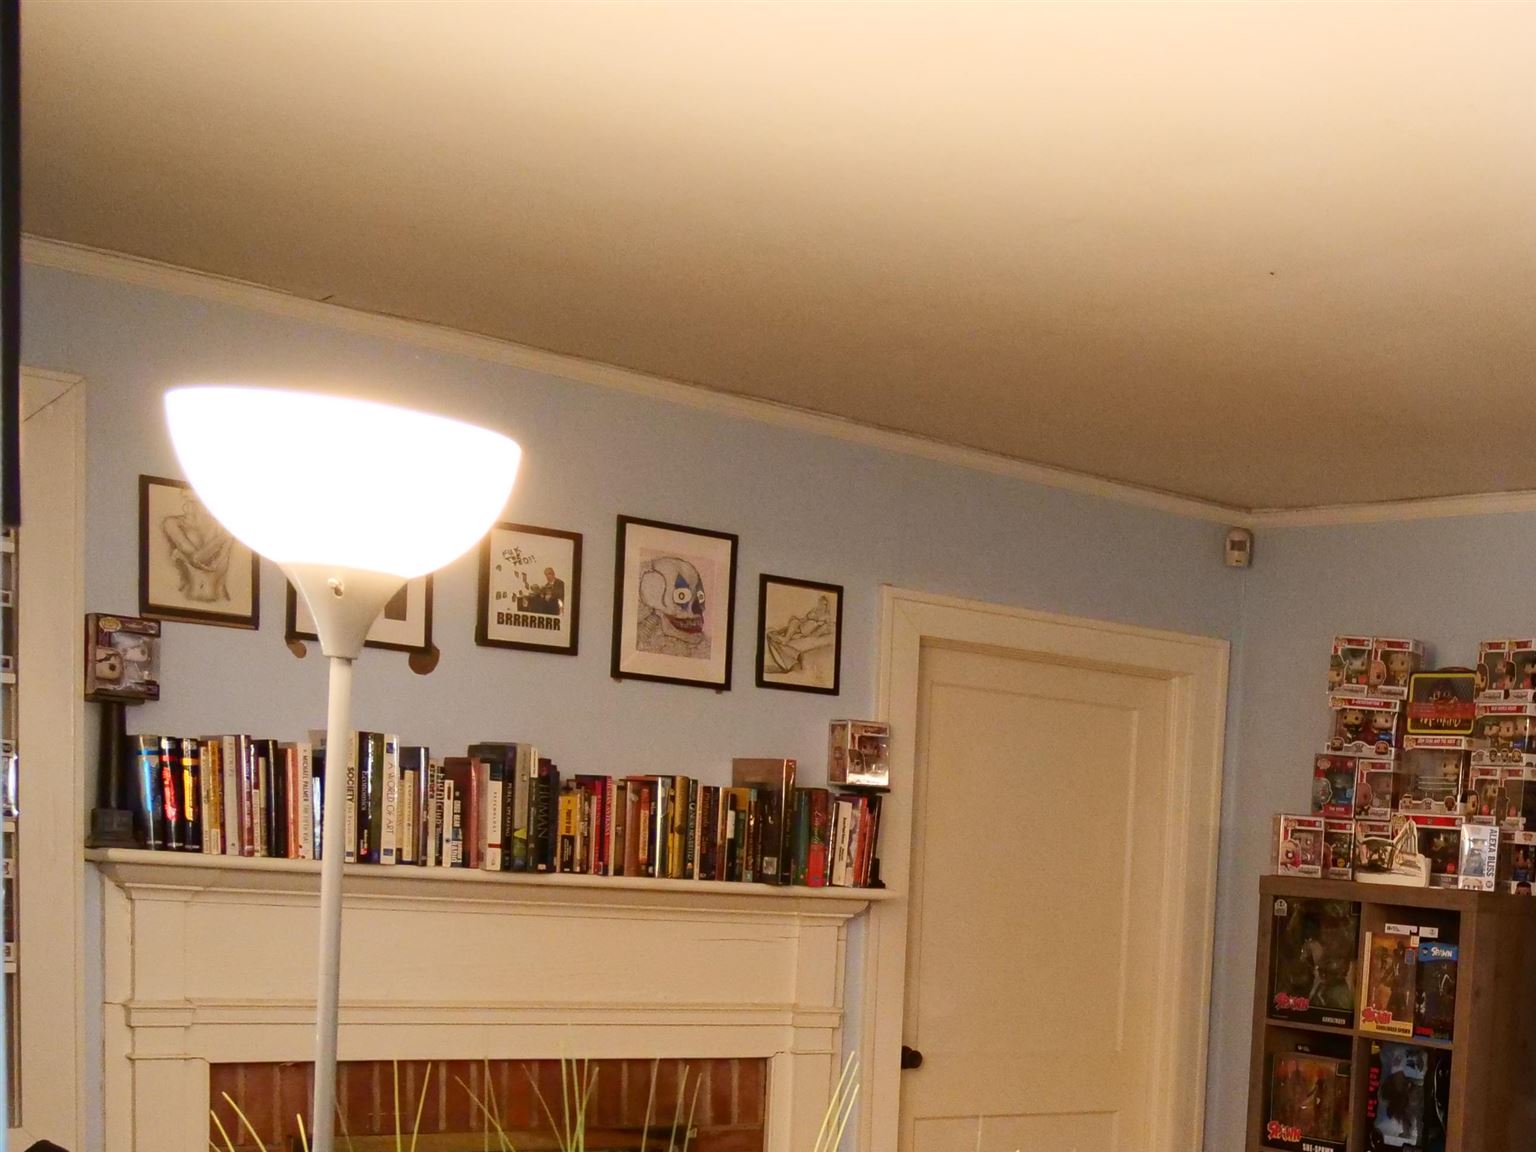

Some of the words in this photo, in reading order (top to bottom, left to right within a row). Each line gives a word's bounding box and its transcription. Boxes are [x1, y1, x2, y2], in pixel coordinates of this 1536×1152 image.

[346, 767, 355, 803] SOCIETY
[538, 784, 549, 838] HUMAN
[385, 819, 395, 835] ART
[1488, 829, 1498, 853] ALEXA
[1487, 855, 1497, 877] BLISS
[1431, 946, 1453, 958] SPAWN
